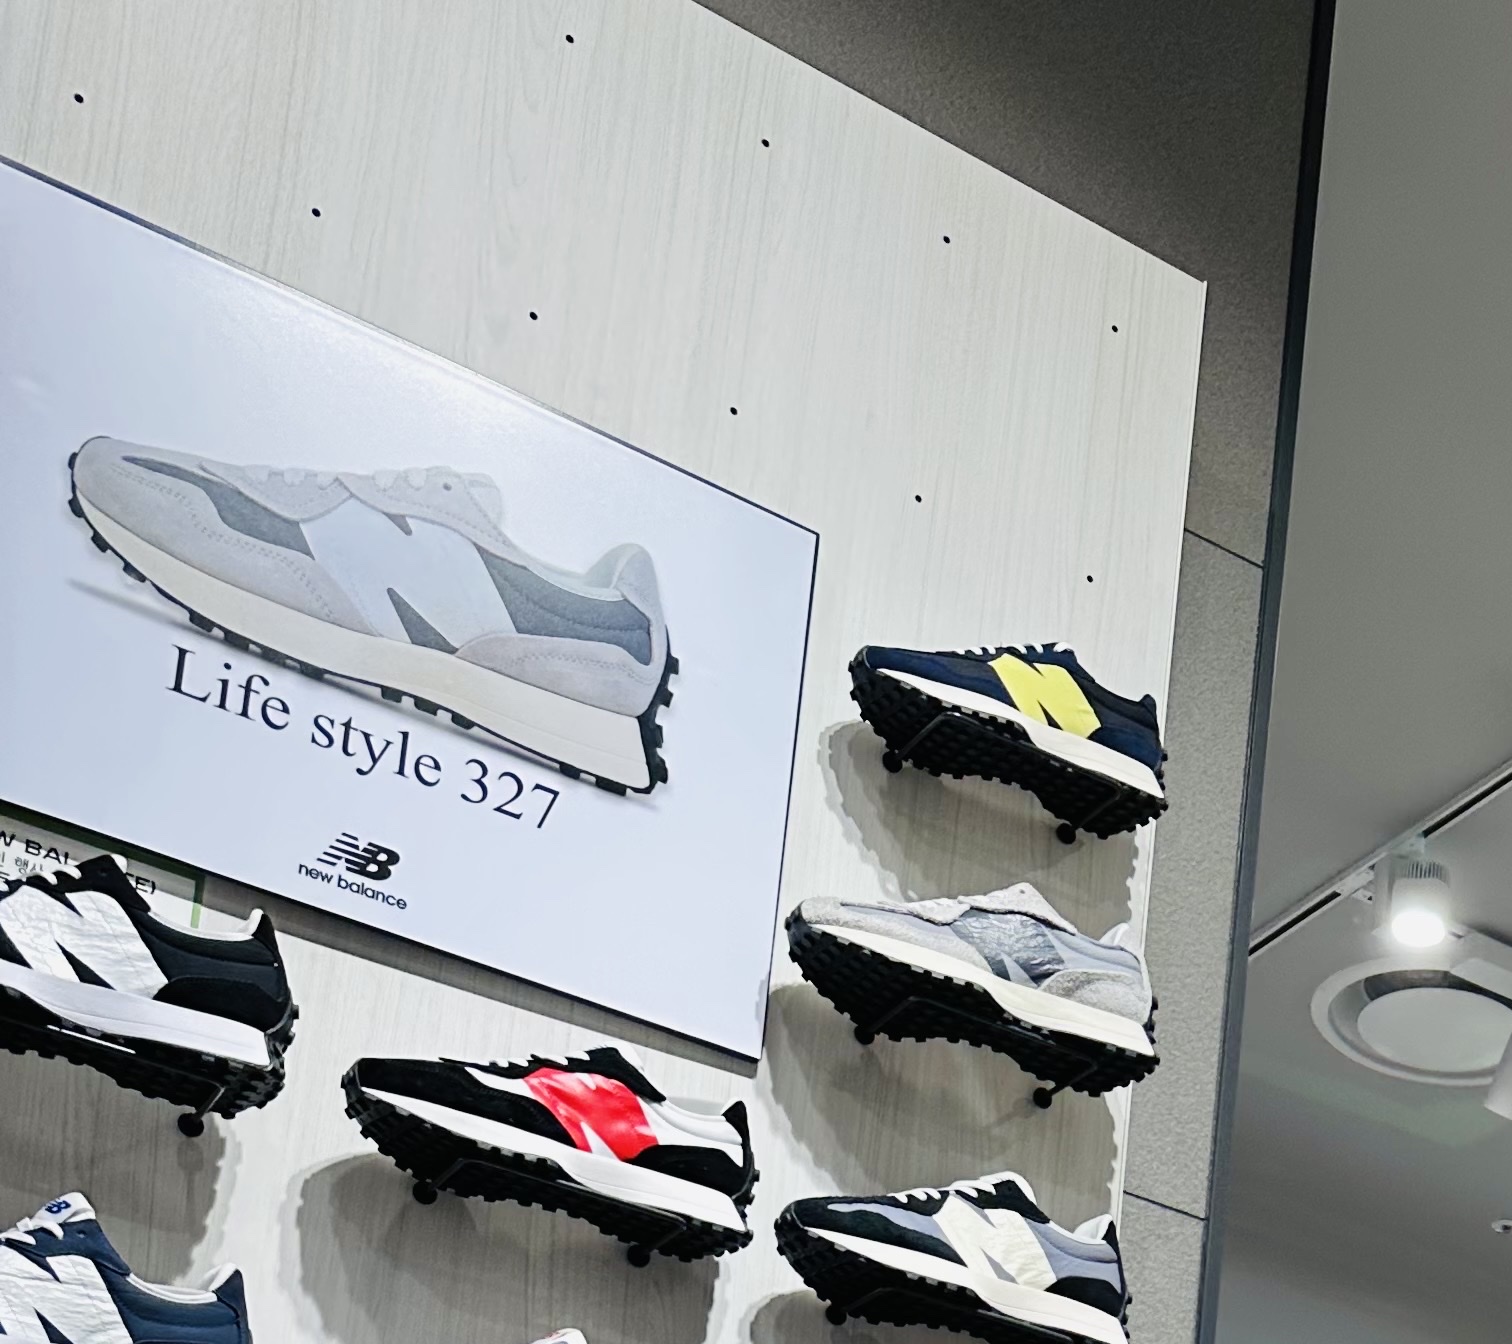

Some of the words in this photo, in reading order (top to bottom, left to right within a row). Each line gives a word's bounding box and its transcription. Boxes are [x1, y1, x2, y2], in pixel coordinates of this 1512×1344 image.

[166, 643, 291, 730] Life
[310, 714, 443, 788] style
[460, 757, 561, 830] 327
[298, 862, 334, 885] new
[337, 873, 408, 911] balance
